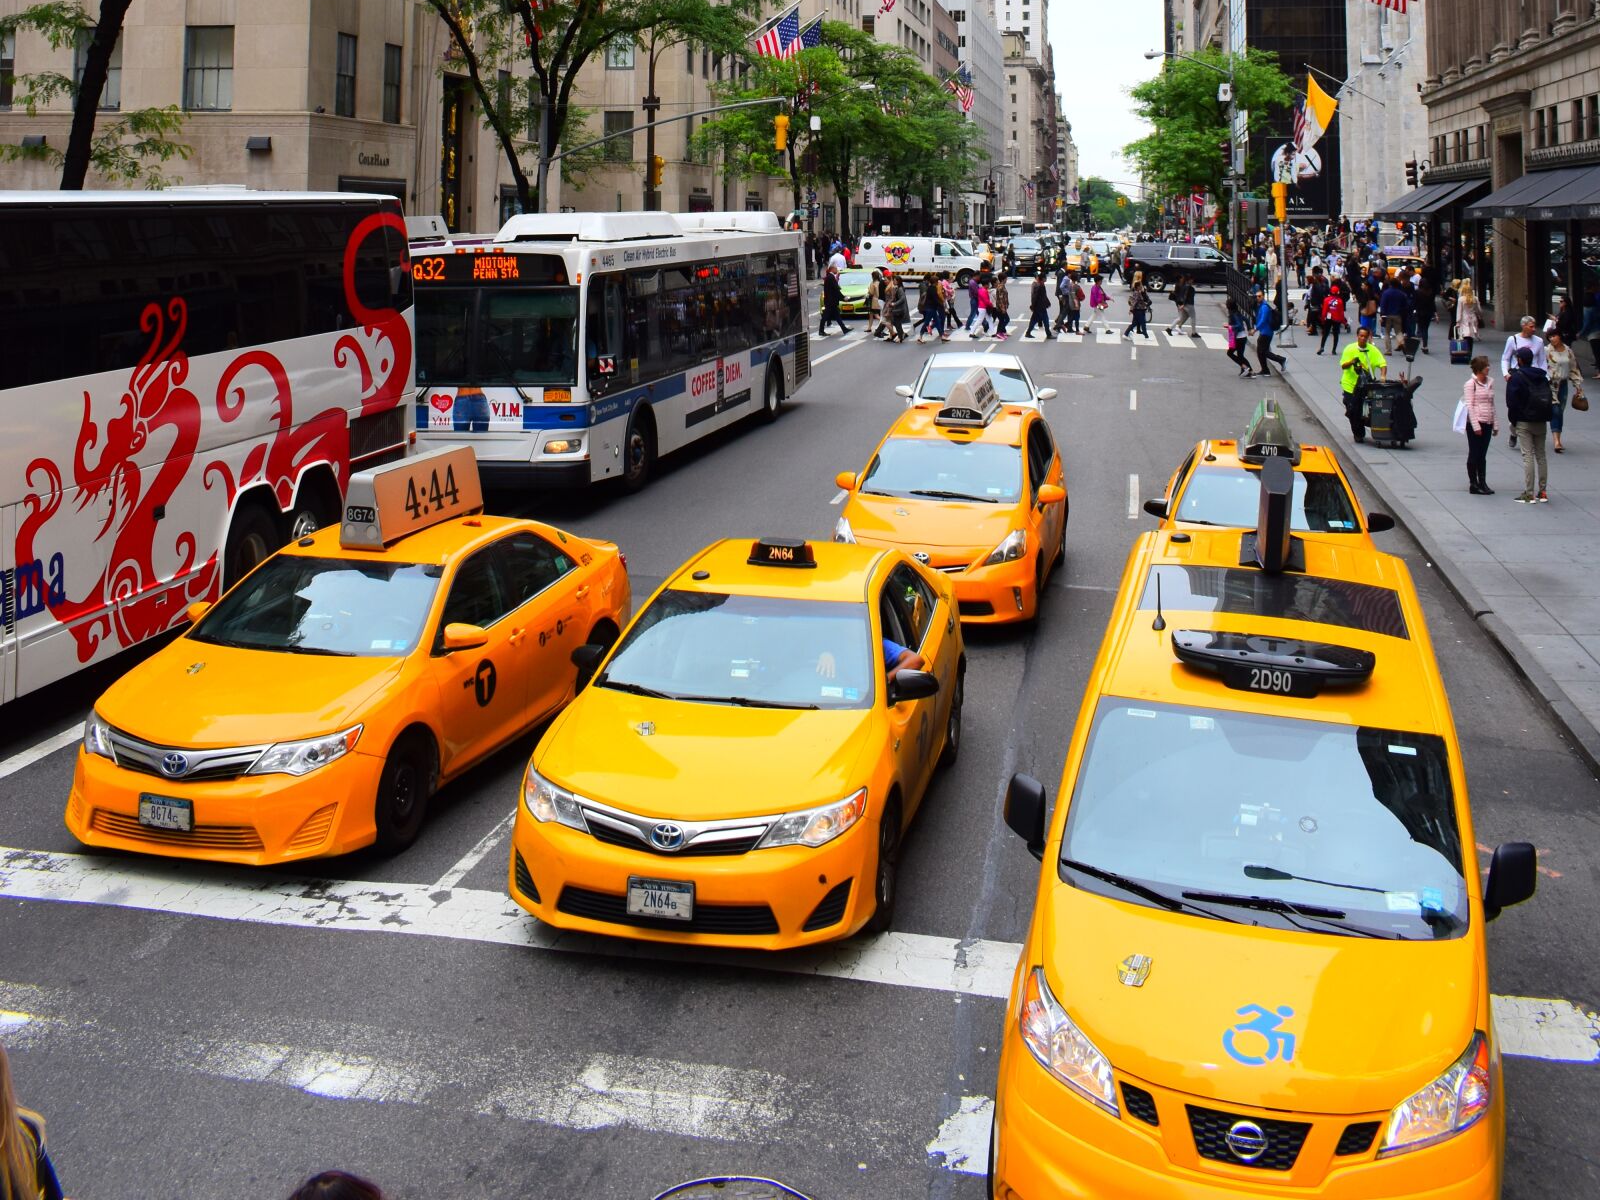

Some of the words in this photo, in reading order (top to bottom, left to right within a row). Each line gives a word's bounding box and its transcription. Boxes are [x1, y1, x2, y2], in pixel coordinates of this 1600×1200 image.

[656, 247, 668, 259] Electric
[413, 257, 446, 280] Q32
[474, 256, 517, 269] MIDTOWN
[473, 268, 498, 280] PENN
[501, 269, 519, 279] STA
[691, 370, 716, 397] COFFEE
[951, 408, 971, 419] 2N72
[1261, 445, 1278, 457] 4V10
[405, 463, 460, 521] 4:44
[347, 508, 375, 522] 8G74
[768, 546, 794, 560] 2N64
[1250, 668, 1292, 692] 2D90
